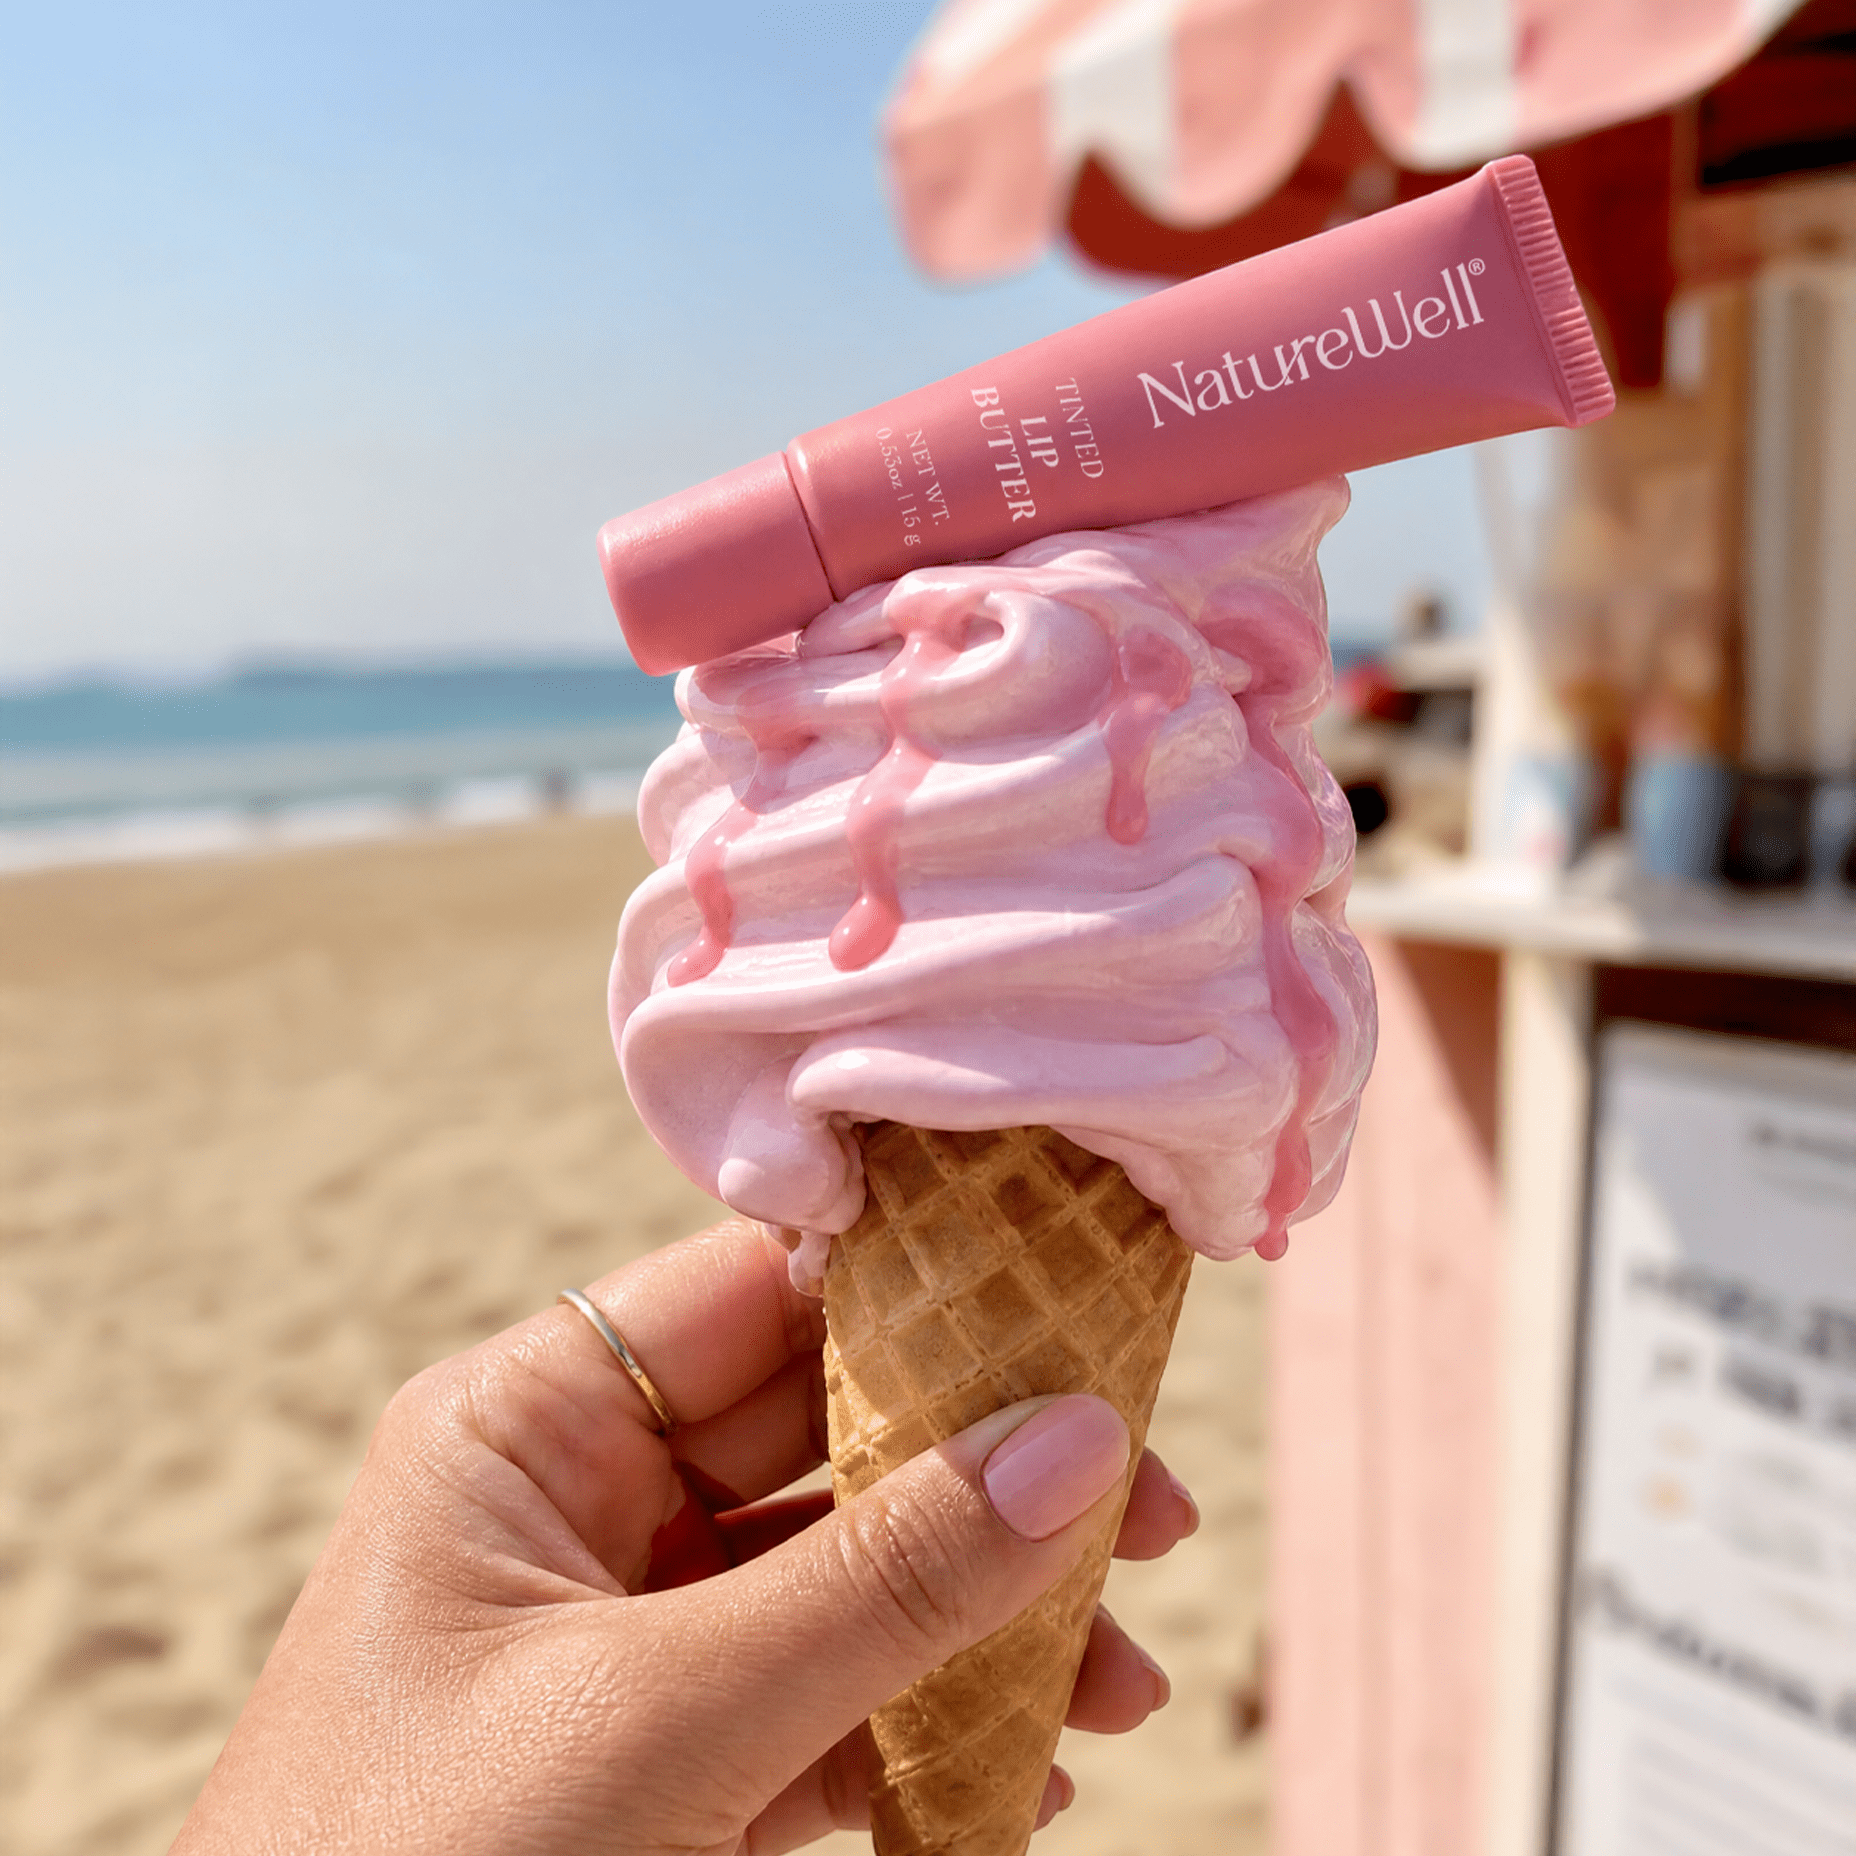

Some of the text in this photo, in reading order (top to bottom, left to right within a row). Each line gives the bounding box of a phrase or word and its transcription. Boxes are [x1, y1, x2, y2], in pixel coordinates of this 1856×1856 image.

[970, 386, 1036, 523] BUTTER
[1020, 416, 1059, 468] LIP
[1055, 377, 1104, 479] TINTED
[906, 427, 950, 526] NET WT.
[902, 506, 921, 528] 15
[904, 534, 922, 546] g
